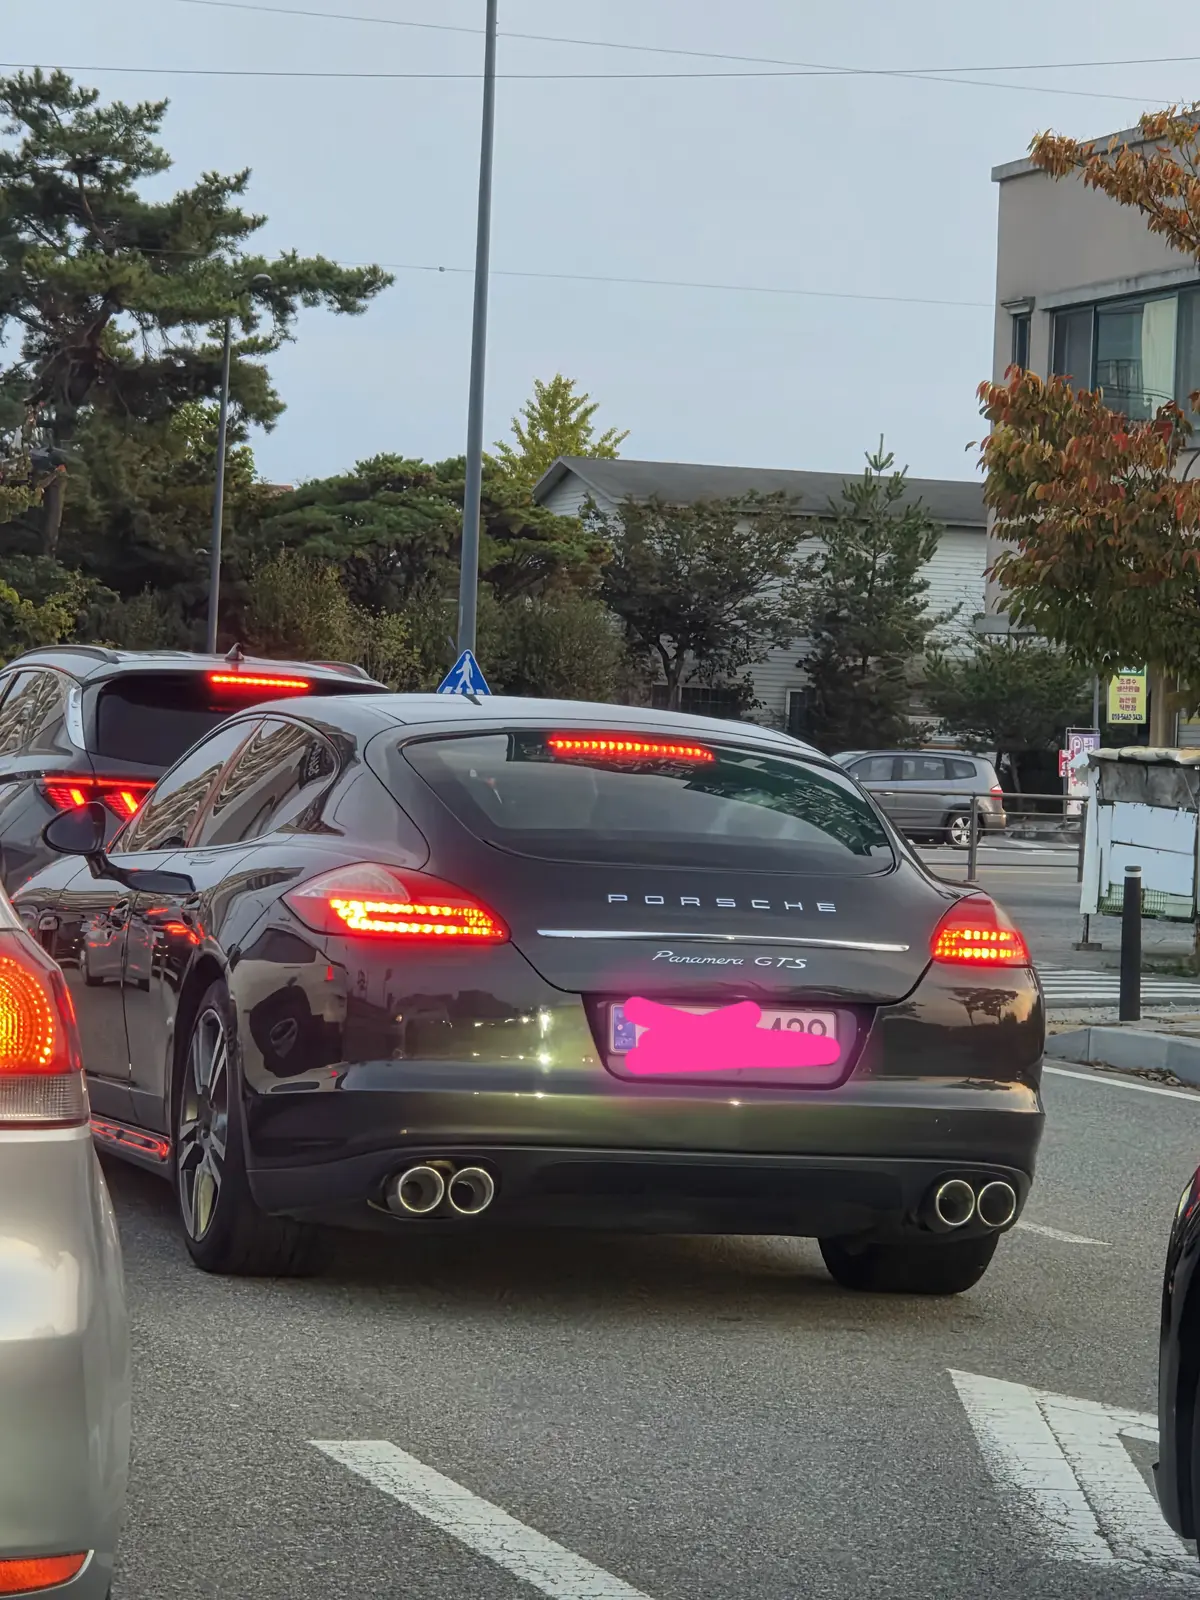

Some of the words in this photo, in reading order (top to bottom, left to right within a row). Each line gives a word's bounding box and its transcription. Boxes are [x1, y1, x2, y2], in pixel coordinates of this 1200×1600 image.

[608, 894, 838, 912] PORSCHE
[652, 950, 744, 966] Panamera
[754, 956, 808, 969] GTS
